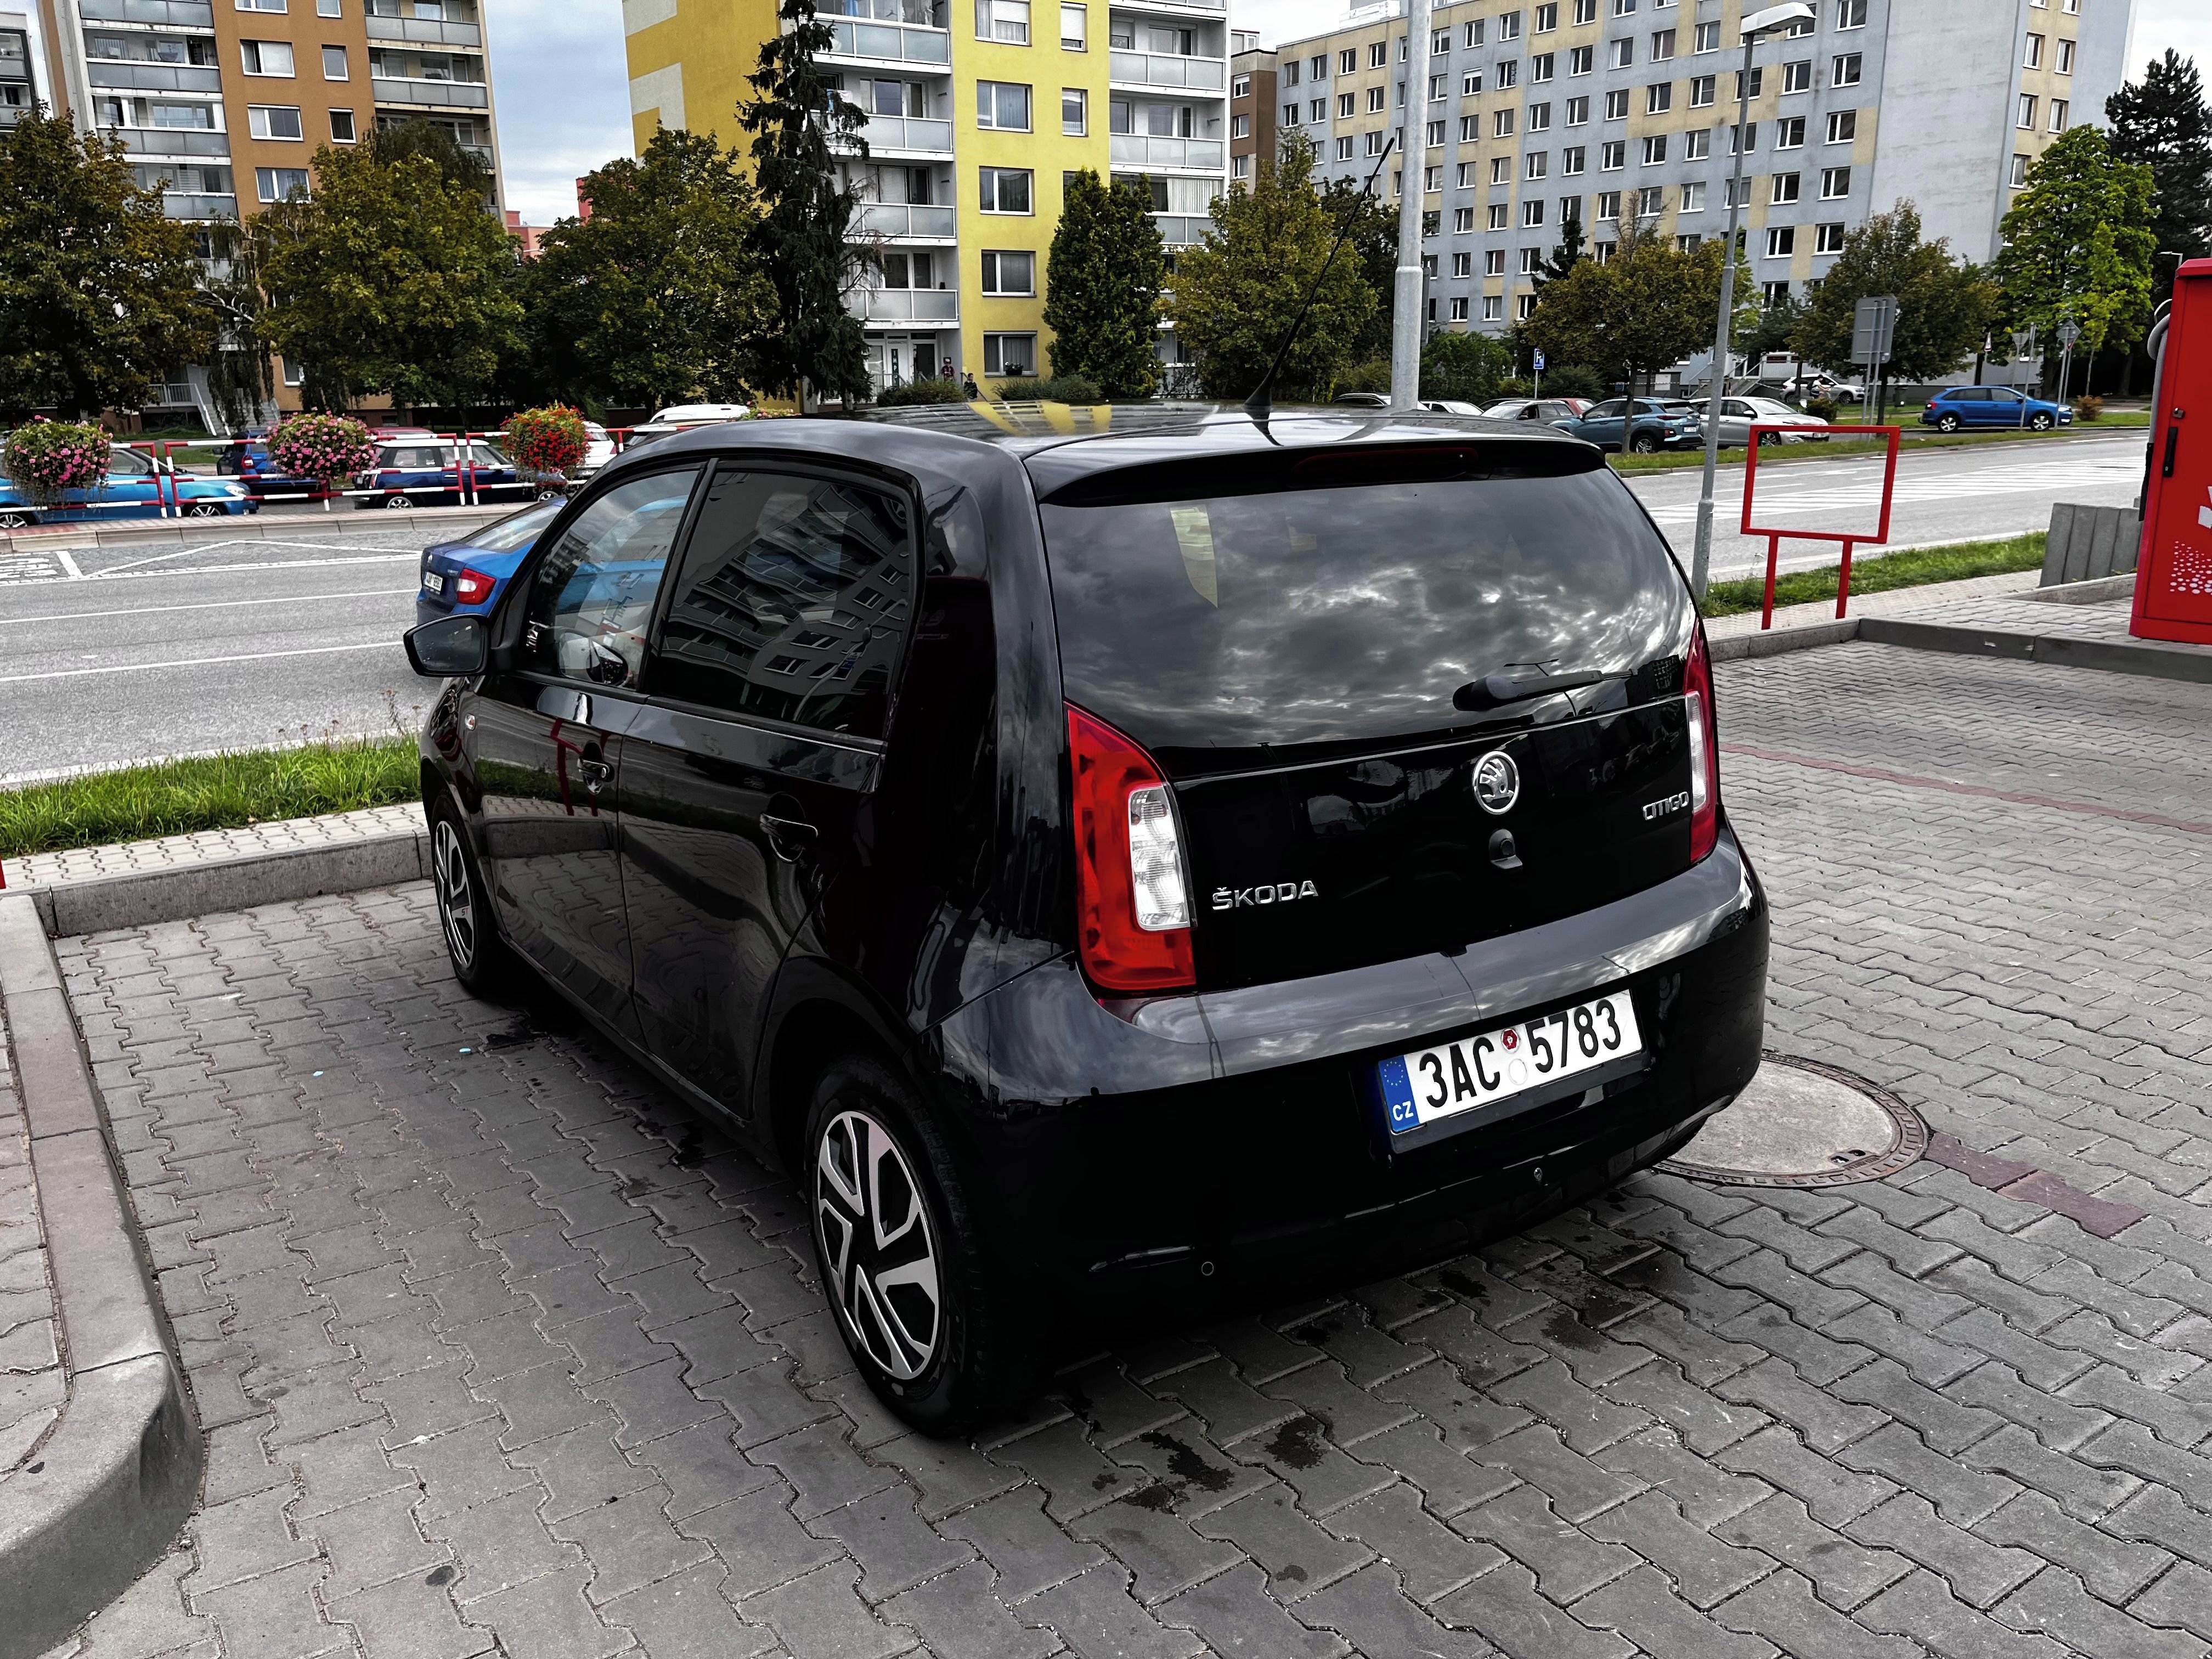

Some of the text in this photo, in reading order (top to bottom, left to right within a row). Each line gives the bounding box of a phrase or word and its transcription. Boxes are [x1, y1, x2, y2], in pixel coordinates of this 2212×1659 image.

[1212, 880, 1319, 910] ŠKODA
[1419, 999, 1621, 1108] 3AC 5783
[1392, 1101, 1414, 1121] CZ
